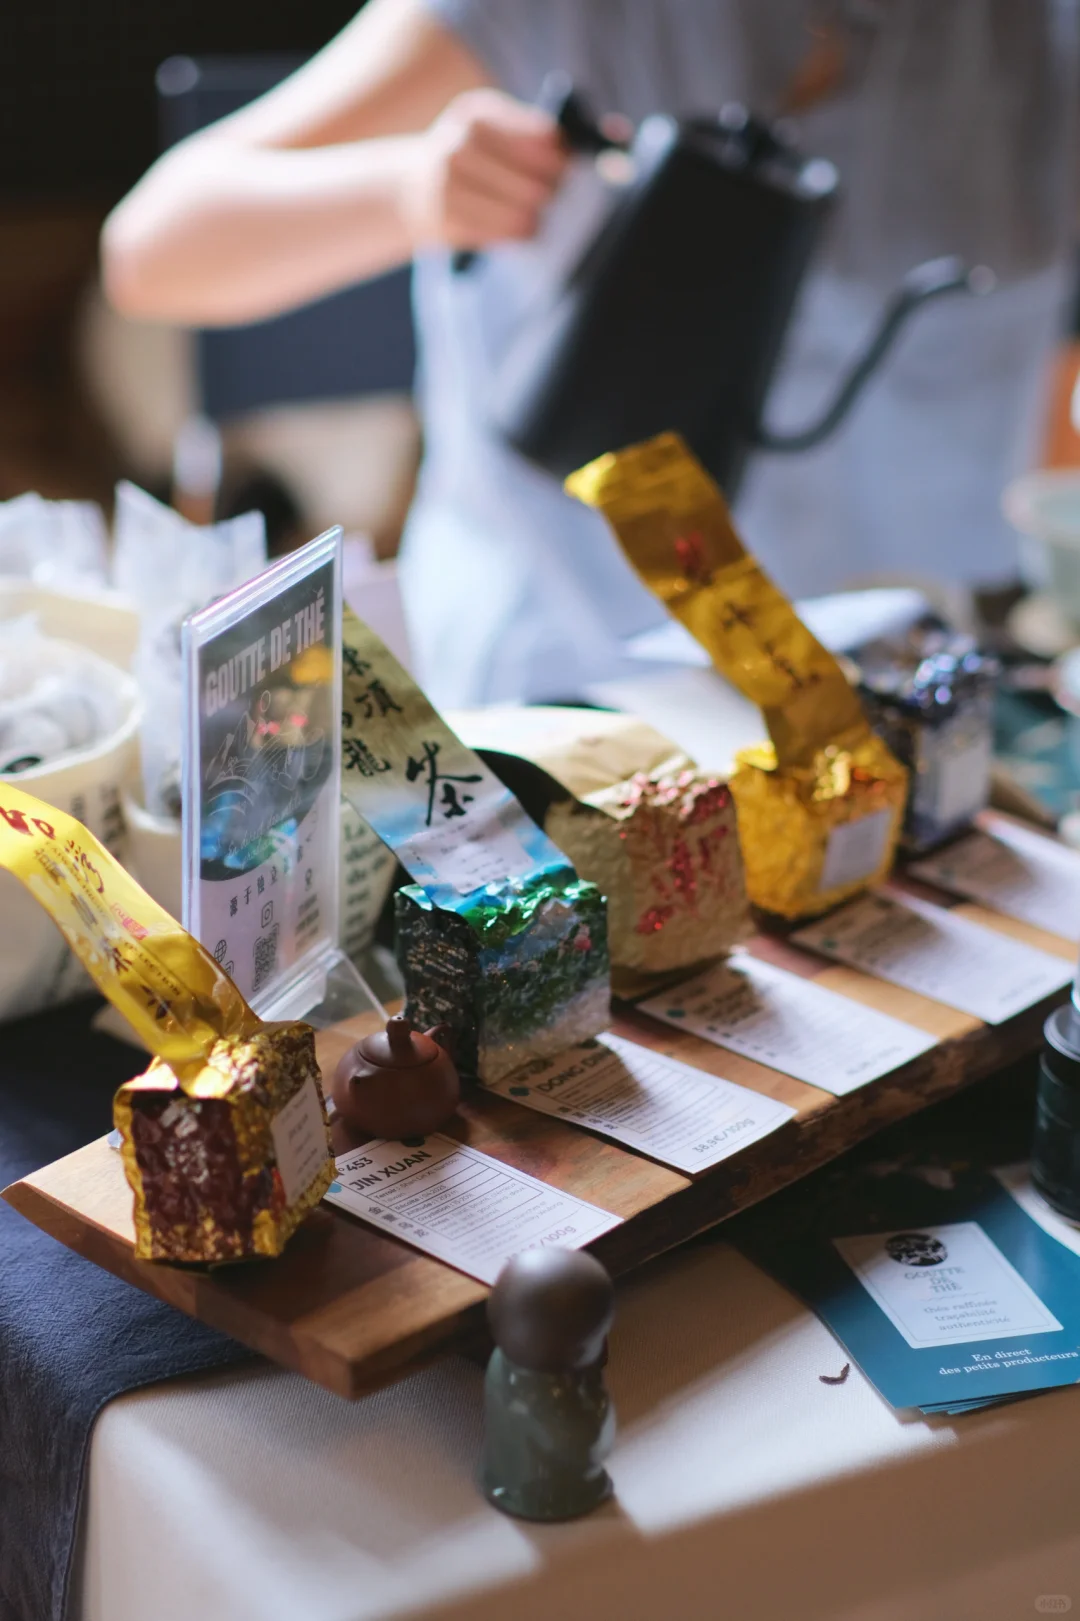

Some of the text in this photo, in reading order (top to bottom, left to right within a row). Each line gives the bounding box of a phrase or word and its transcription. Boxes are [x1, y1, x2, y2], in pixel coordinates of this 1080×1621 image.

[205, 587, 325, 717] GOUTTE DE THÉ
[406, 741, 483, 827] 茶
[347, 1149, 434, 1191] JIN XUAN
[904, 1266, 965, 1281] GOUTTE
[938, 1316, 1010, 1331] authenticité
[939, 1350, 1079, 1376] des petits producteurs
[971, 1348, 1032, 1362] En direct
